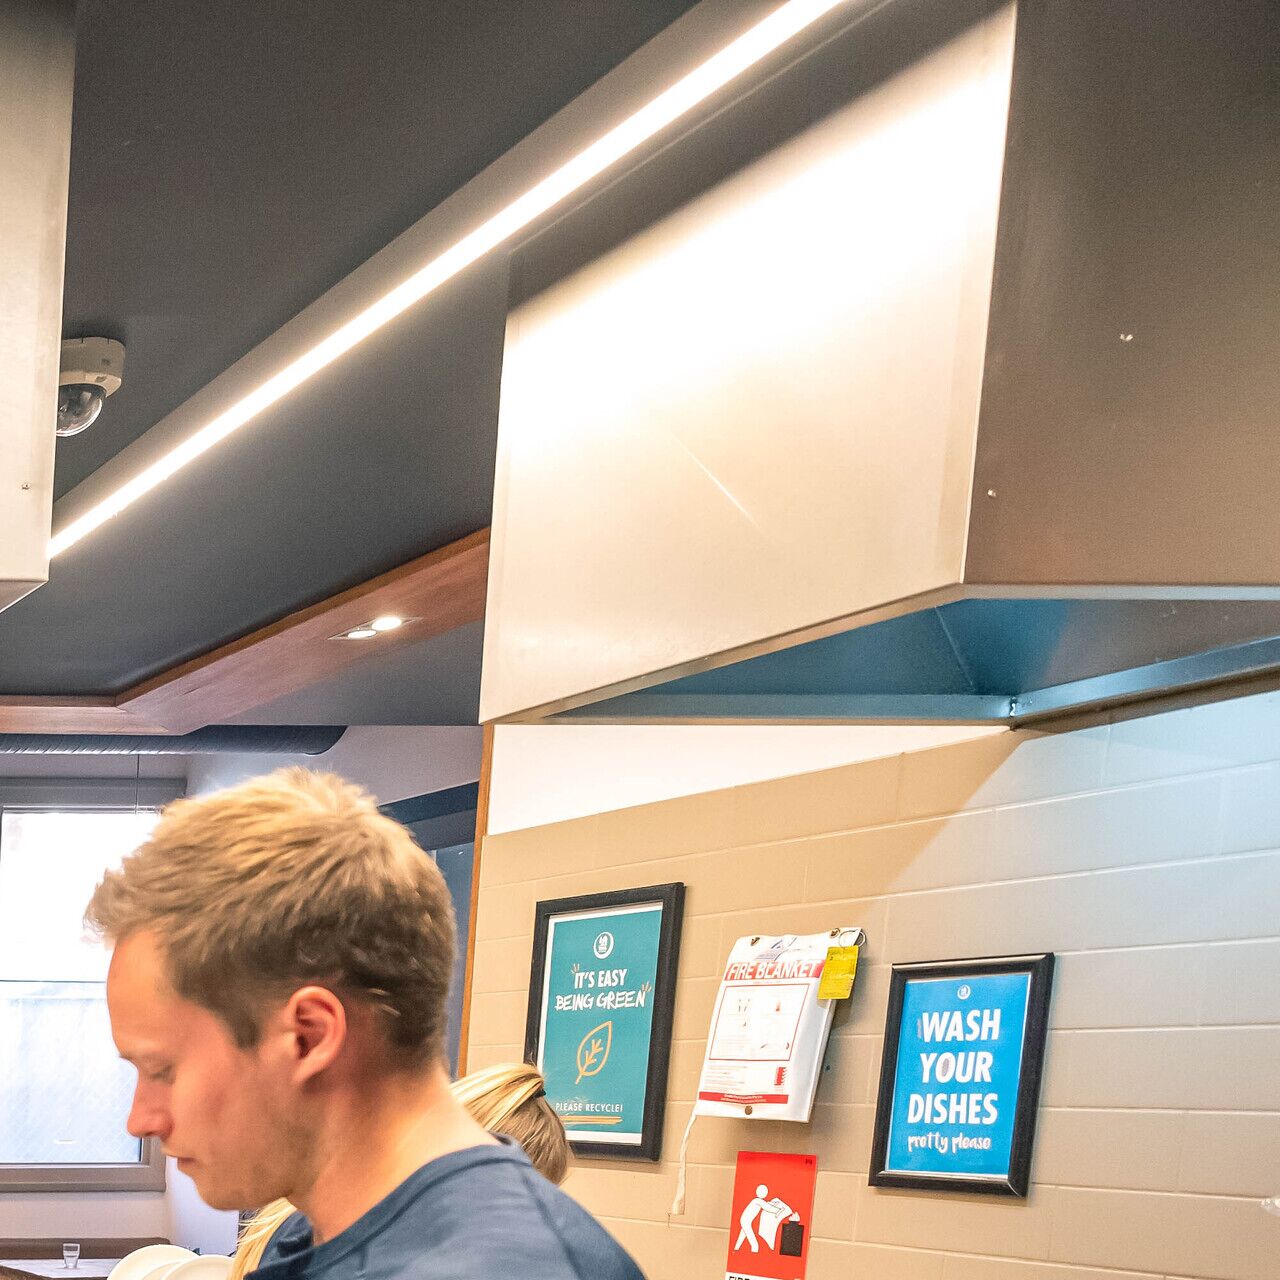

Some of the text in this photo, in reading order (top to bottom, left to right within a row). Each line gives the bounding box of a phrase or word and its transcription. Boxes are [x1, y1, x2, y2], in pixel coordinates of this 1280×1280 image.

[575, 968, 627, 989] IT'S EASY
[727, 959, 818, 980] FIRE BLANKET
[554, 989, 646, 1011] BEING GREEN
[922, 1008, 1001, 1043] WASH
[920, 1051, 993, 1084] YOUR
[555, 1102, 623, 1113] PLEASE RECYCLE!
[907, 1092, 998, 1125] DISHES
[908, 1132, 991, 1154] pretty please
